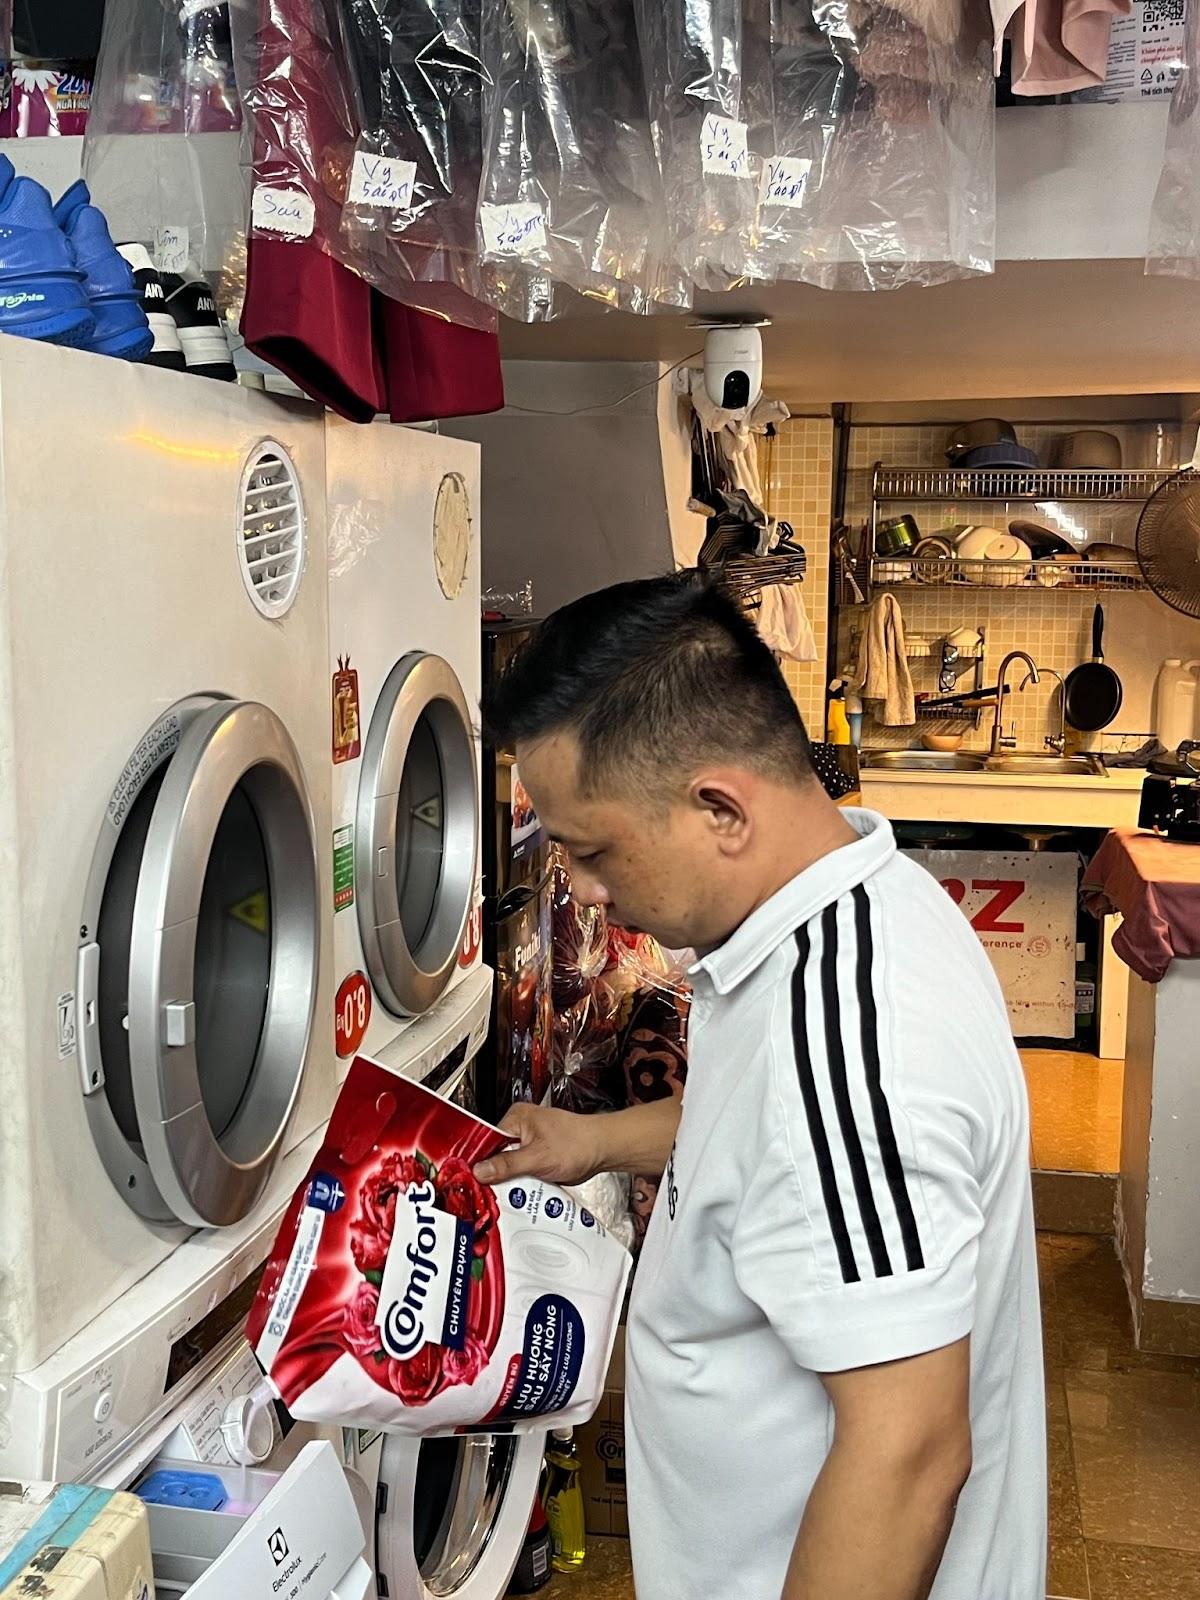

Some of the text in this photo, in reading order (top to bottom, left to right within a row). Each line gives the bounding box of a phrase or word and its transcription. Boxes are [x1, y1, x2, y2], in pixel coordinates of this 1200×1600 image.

[384, 1184, 439, 1355] Comfort
[450, 1234, 468, 1336] CHUYÊN DỤNG
[513, 1322, 544, 1410] LƯU HƯƠNG
[524, 1386, 545, 1411] SAU
[539, 1352, 553, 1383] SẤY
[272, 1556, 302, 1593] Electrolux
